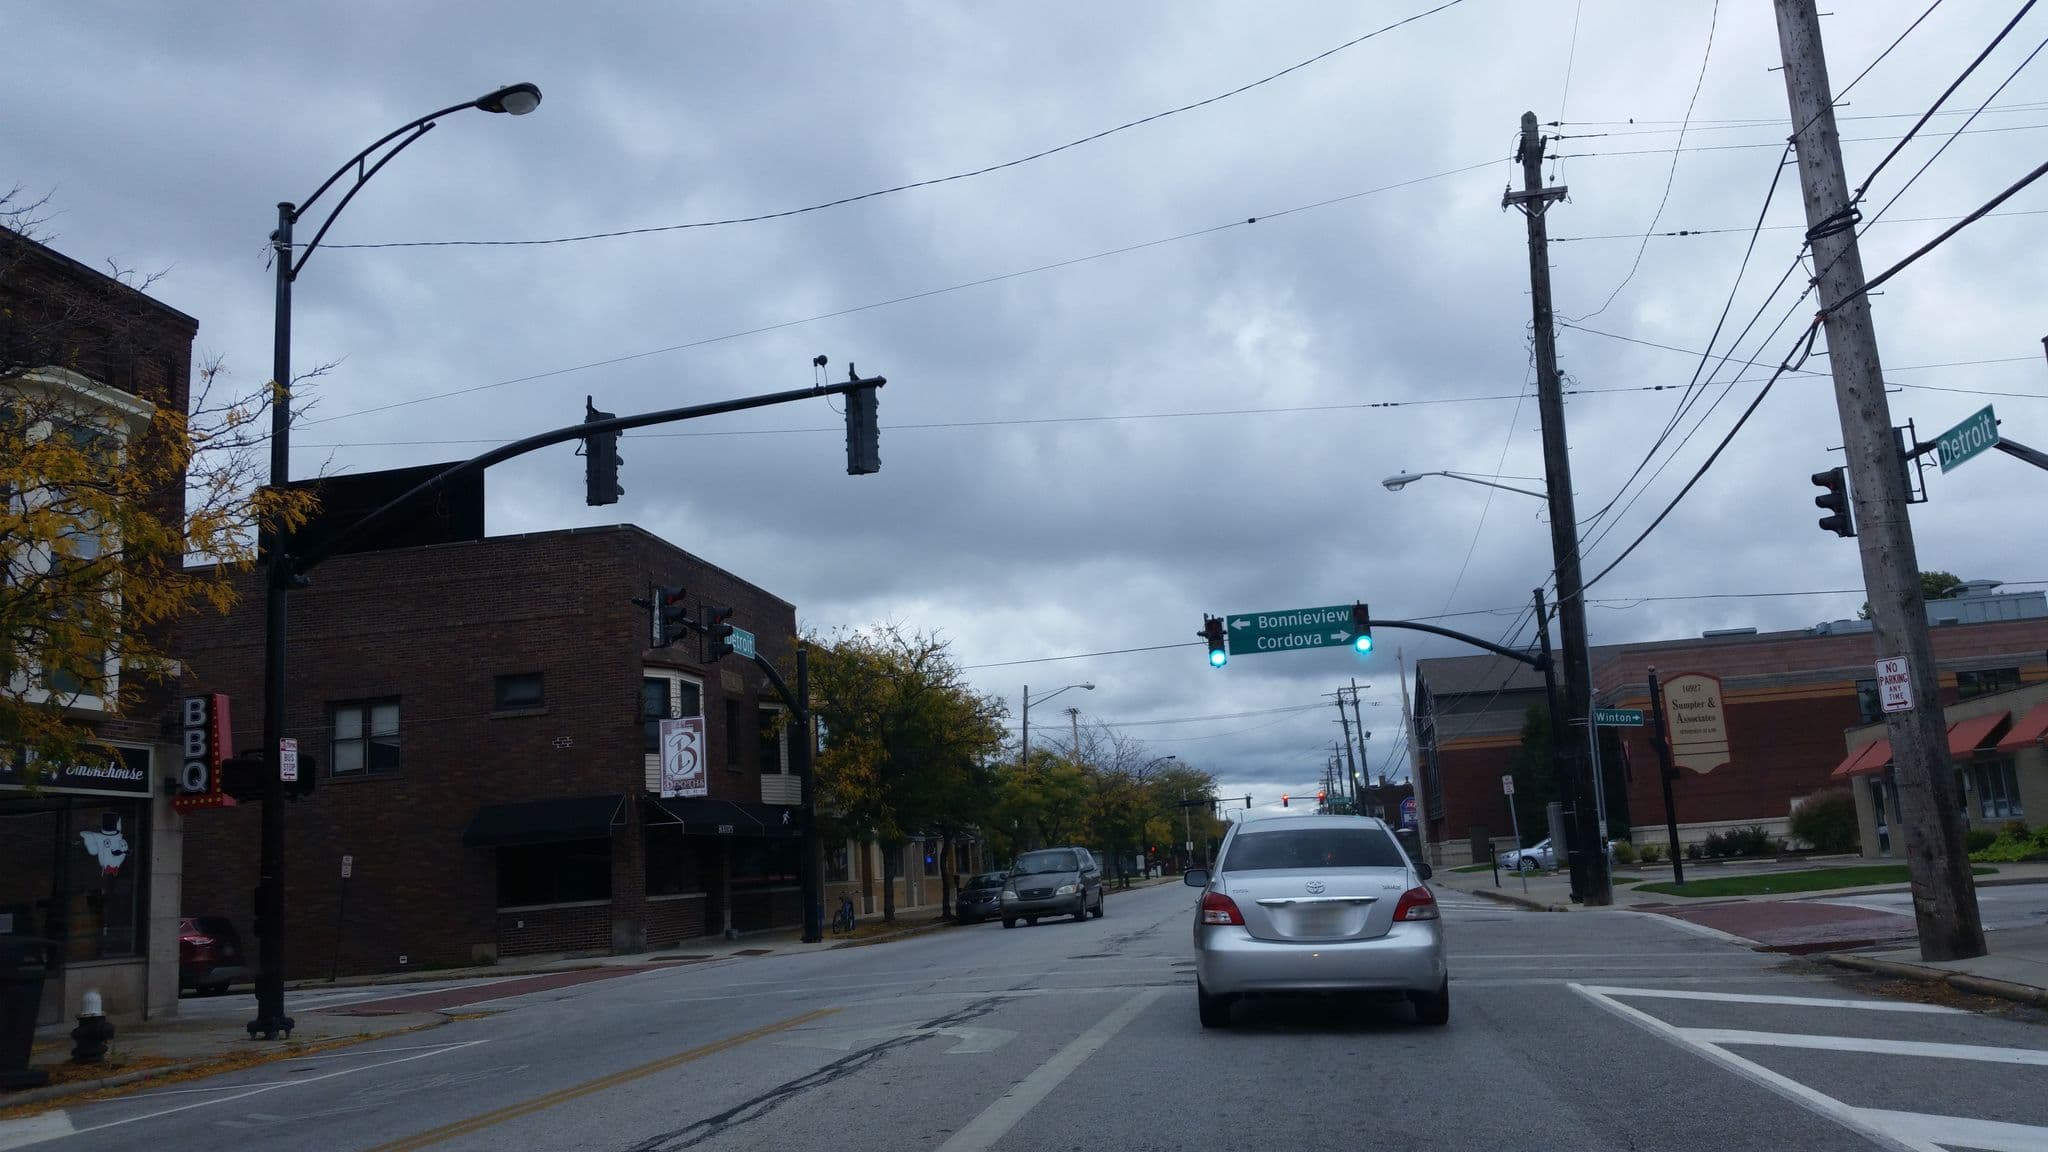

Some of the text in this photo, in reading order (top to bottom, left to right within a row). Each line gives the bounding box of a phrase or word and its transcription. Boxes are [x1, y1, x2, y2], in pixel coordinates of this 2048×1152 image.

[1941, 414, 1993, 465] Detroit
[1258, 608, 1349, 629] Bonnieview
[1257, 633, 1322, 649] Cordova
[1885, 662, 1898, 673] NO
[1879, 673, 1908, 685] PARKING
[1672, 696, 1716, 710] Sumpter &
[1888, 693, 1904, 701] TIME
[1596, 711, 1632, 722] Winton
[1677, 712, 1717, 724] Associates
[183, 698, 208, 793] BBQ
[284, 753, 295, 762] BUS
[283, 763, 296, 772] STOP
